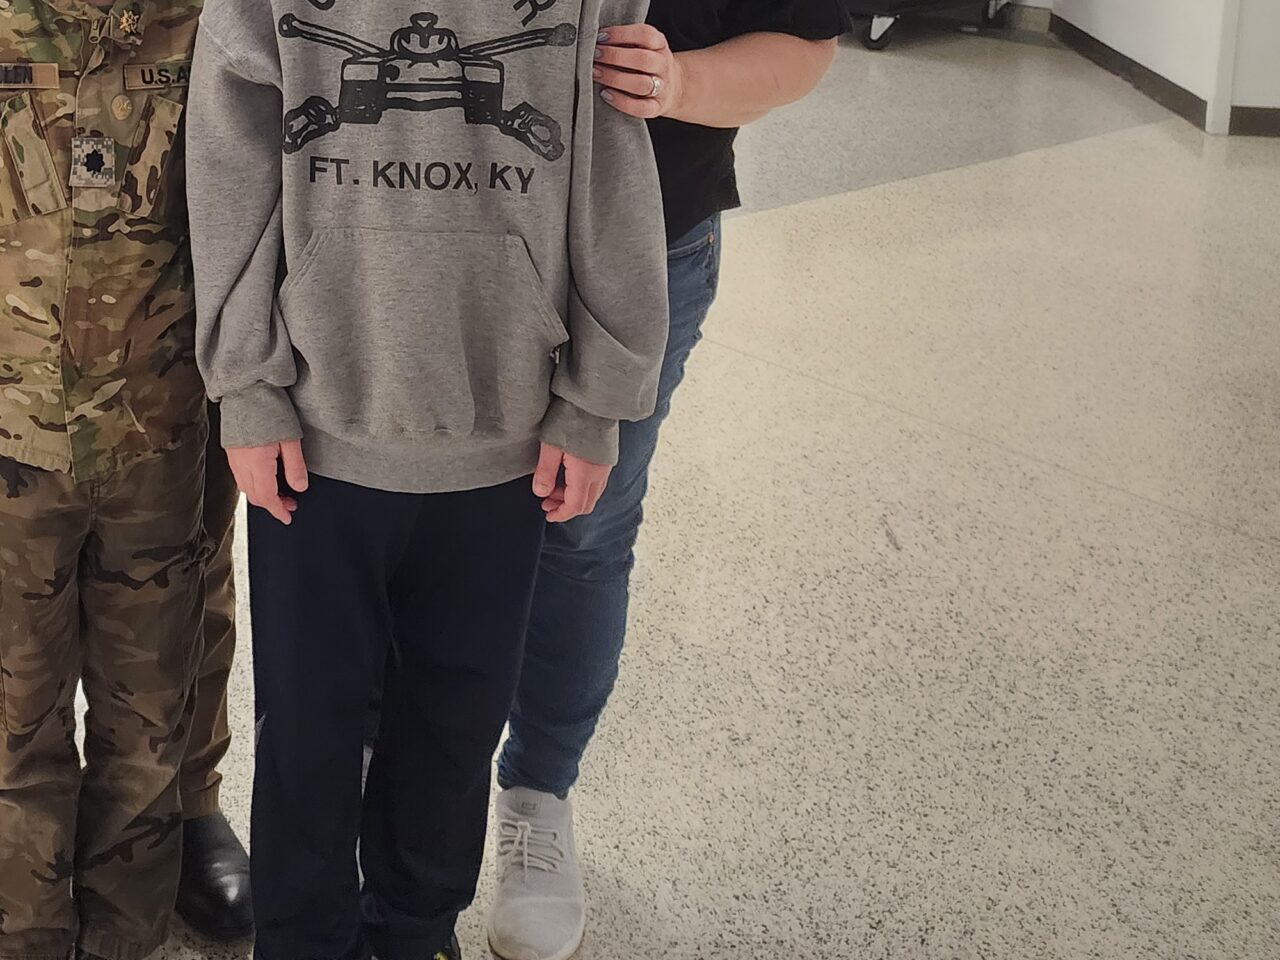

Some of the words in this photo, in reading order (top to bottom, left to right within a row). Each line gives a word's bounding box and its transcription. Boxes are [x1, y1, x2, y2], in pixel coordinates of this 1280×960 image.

[309, 155, 360, 185] FT.
[372, 159, 478, 195] KNOX,
[489, 161, 535, 194] KY
